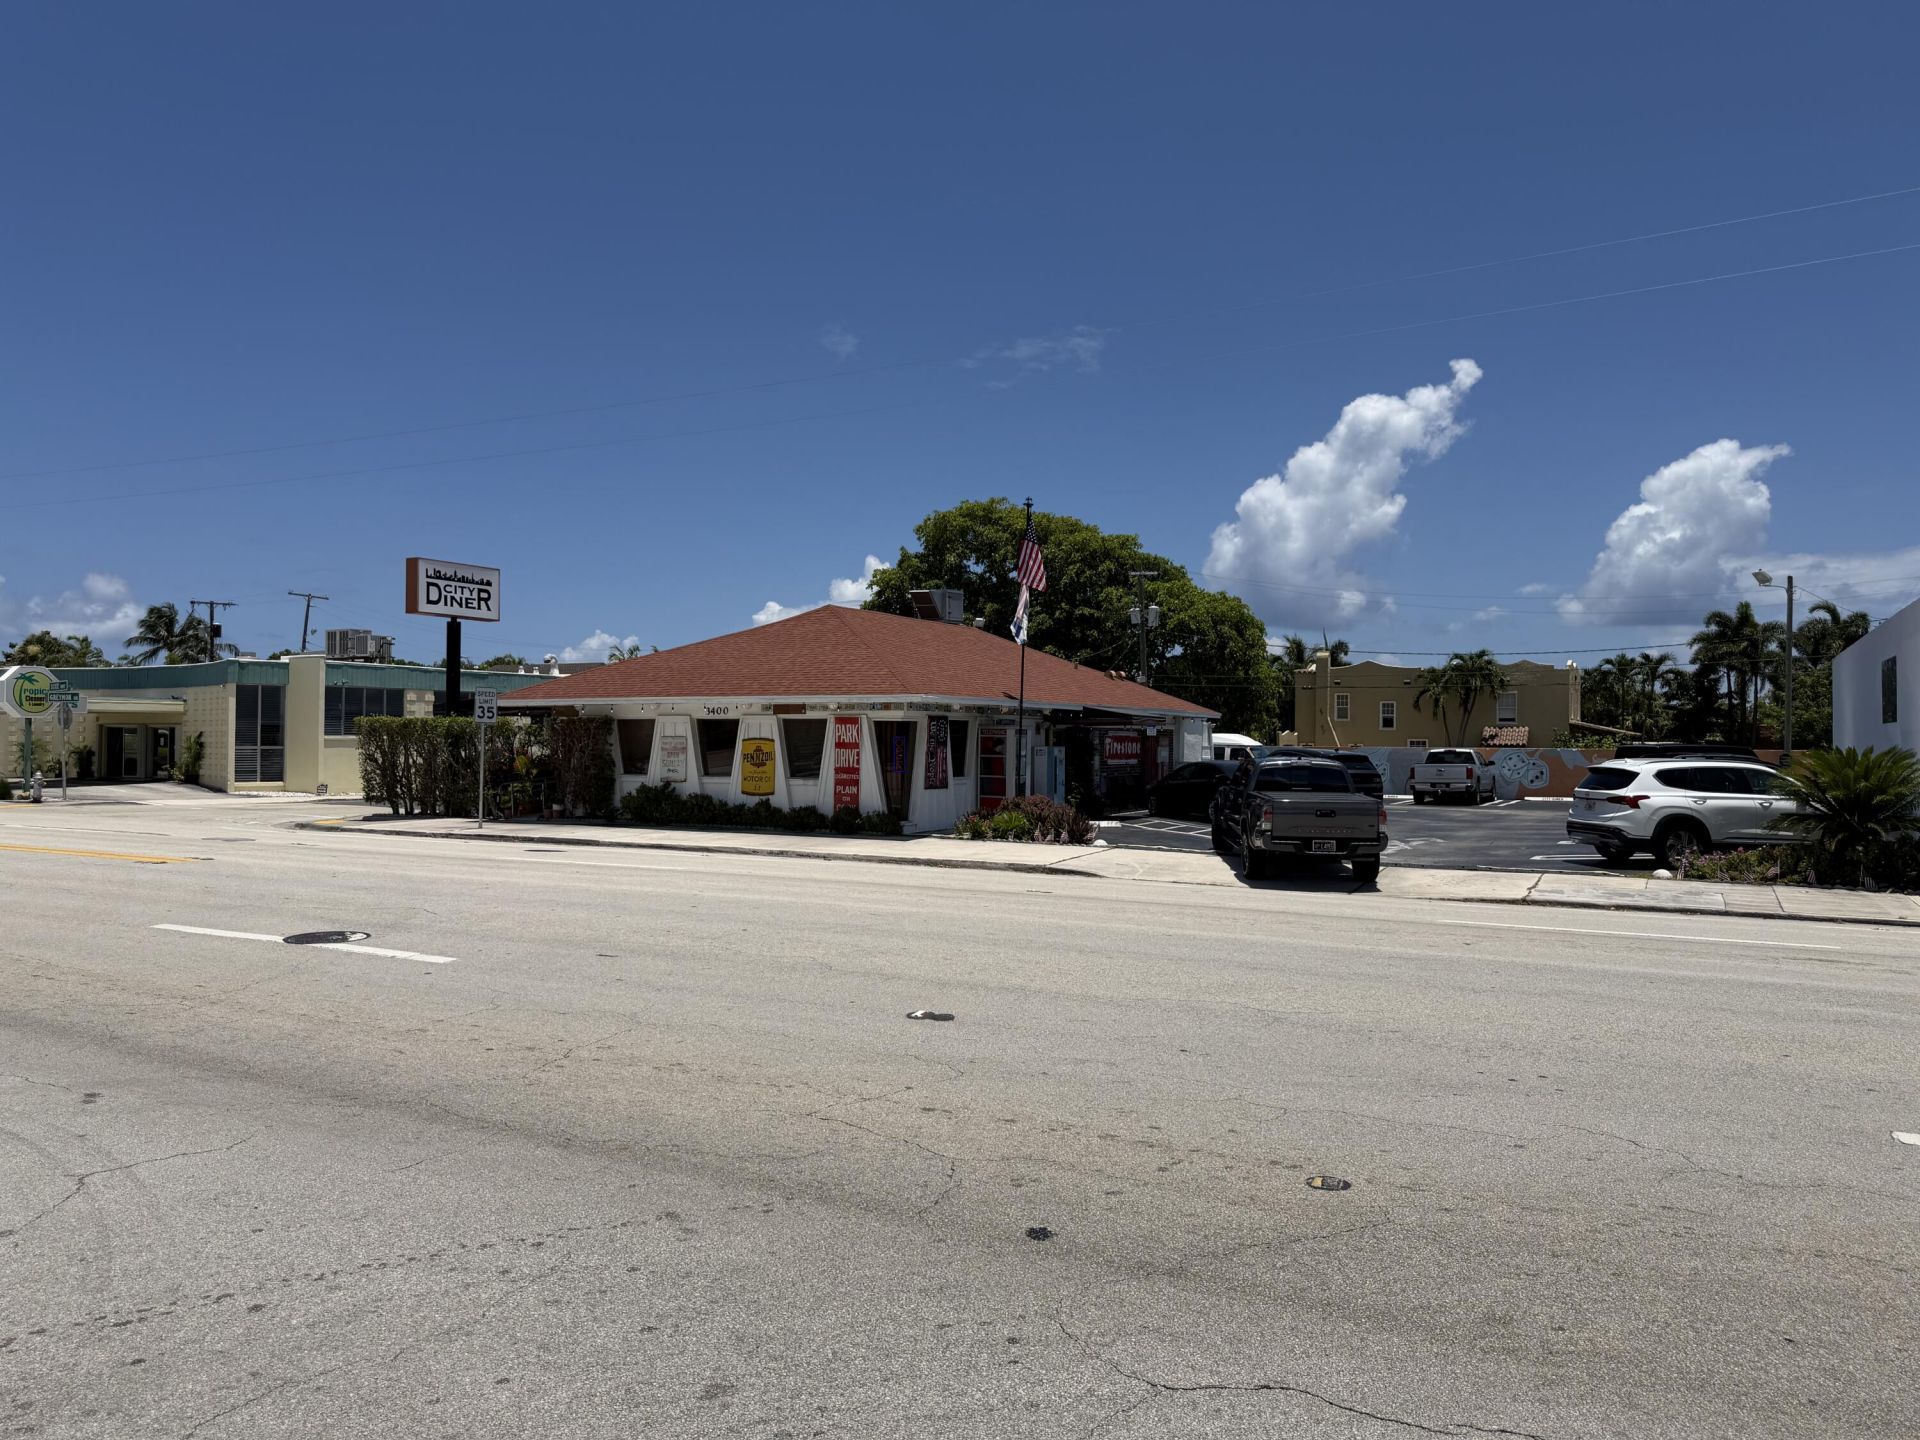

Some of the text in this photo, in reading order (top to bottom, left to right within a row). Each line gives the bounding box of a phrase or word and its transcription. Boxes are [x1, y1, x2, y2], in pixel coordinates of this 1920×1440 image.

[425, 580, 492, 612] DINER
[443, 584, 476, 597] CITY
[477, 690, 496, 698] SPEED
[477, 705, 495, 719] 35
[704, 706, 729, 715] 3400
[835, 723, 859, 743] PARK
[1105, 737, 1141, 757] Firestone
[743, 751, 774, 763] PENNZOIL
[835, 748, 860, 768] DRIVE
[836, 785, 858, 794] PLAIN
